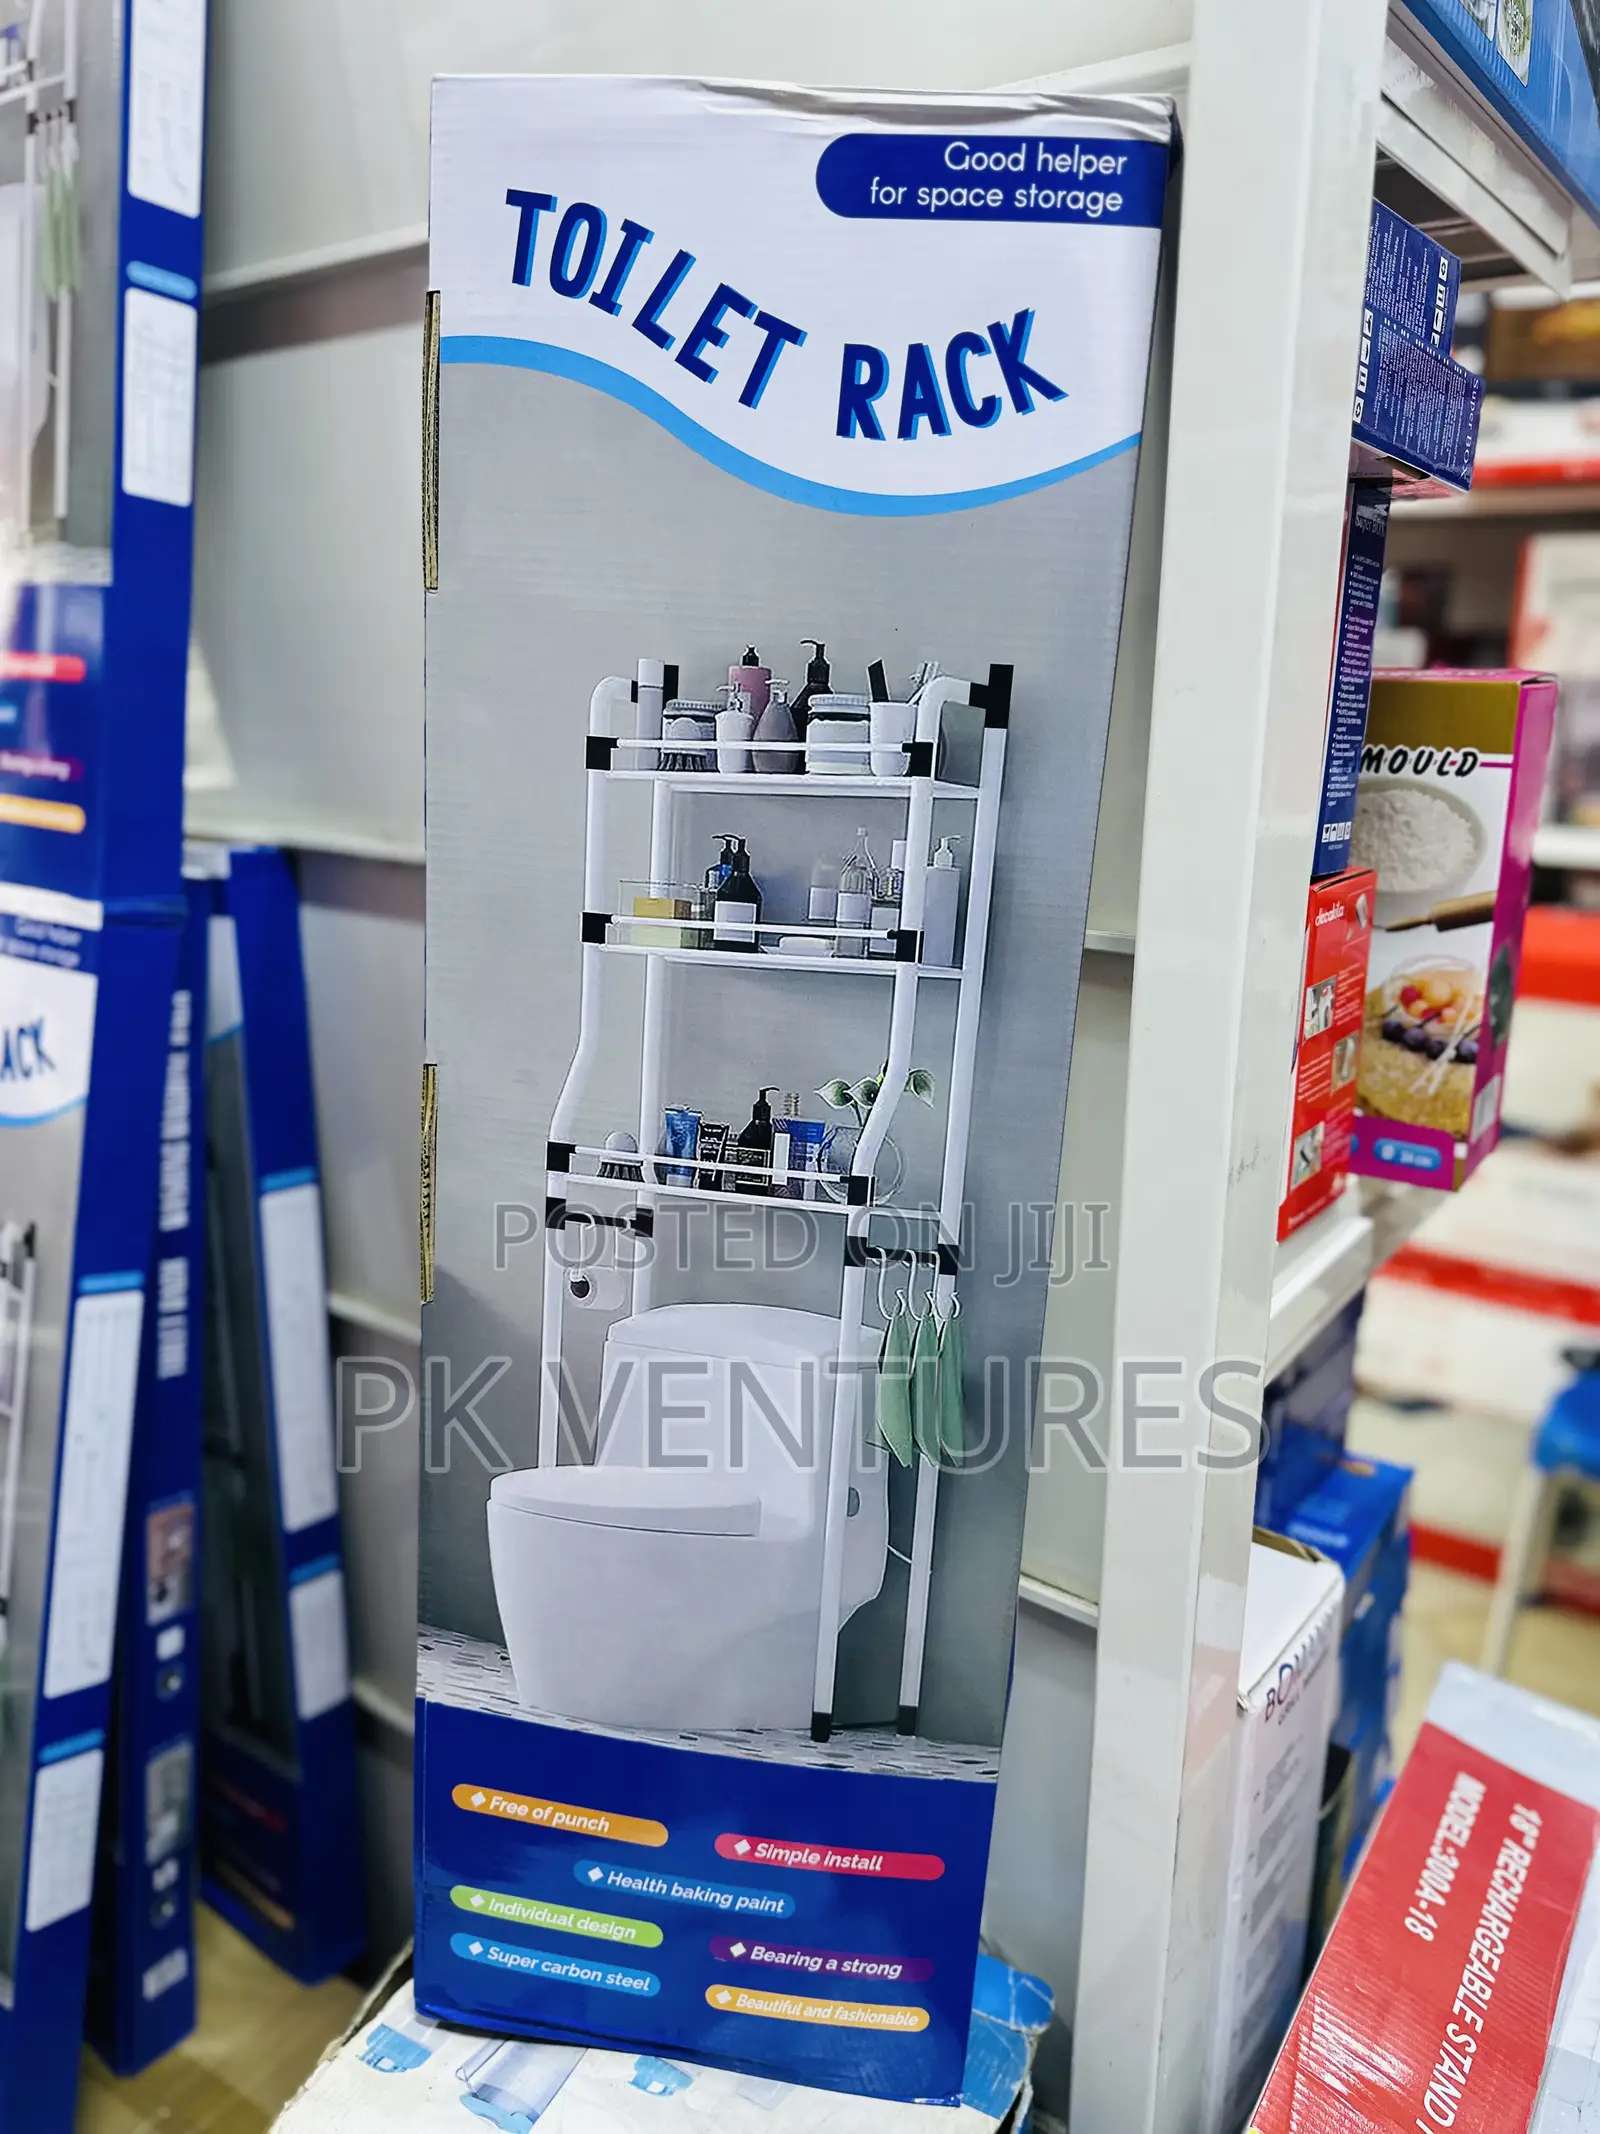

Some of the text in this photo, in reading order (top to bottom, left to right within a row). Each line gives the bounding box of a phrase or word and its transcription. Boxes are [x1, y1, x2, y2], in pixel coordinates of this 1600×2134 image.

[944, 142, 1127, 178] Good helper
[870, 177, 1124, 217] for space storage
[505, 188, 1069, 441] TOILET RACK
[1468, 377, 1479, 431] Super
[1360, 747, 1479, 778] MOULD
[489, 1795, 610, 1835] Free of punch
[754, 1841, 884, 1872] Simple install
[1404, 1770, 1487, 1942] MODEL:300A-18
[606, 1869, 786, 1915] Health baking paint
[487, 1896, 637, 1941] Individual design
[1452, 1837, 1532, 2034] RECHARGEABLE
[487, 1945, 651, 1991] Super carbon steel
[751, 1944, 903, 1980] Bearing a strong
[735, 1993, 919, 2029] Beautiful and fashionable
[1423, 2022, 1478, 2128] STAND
